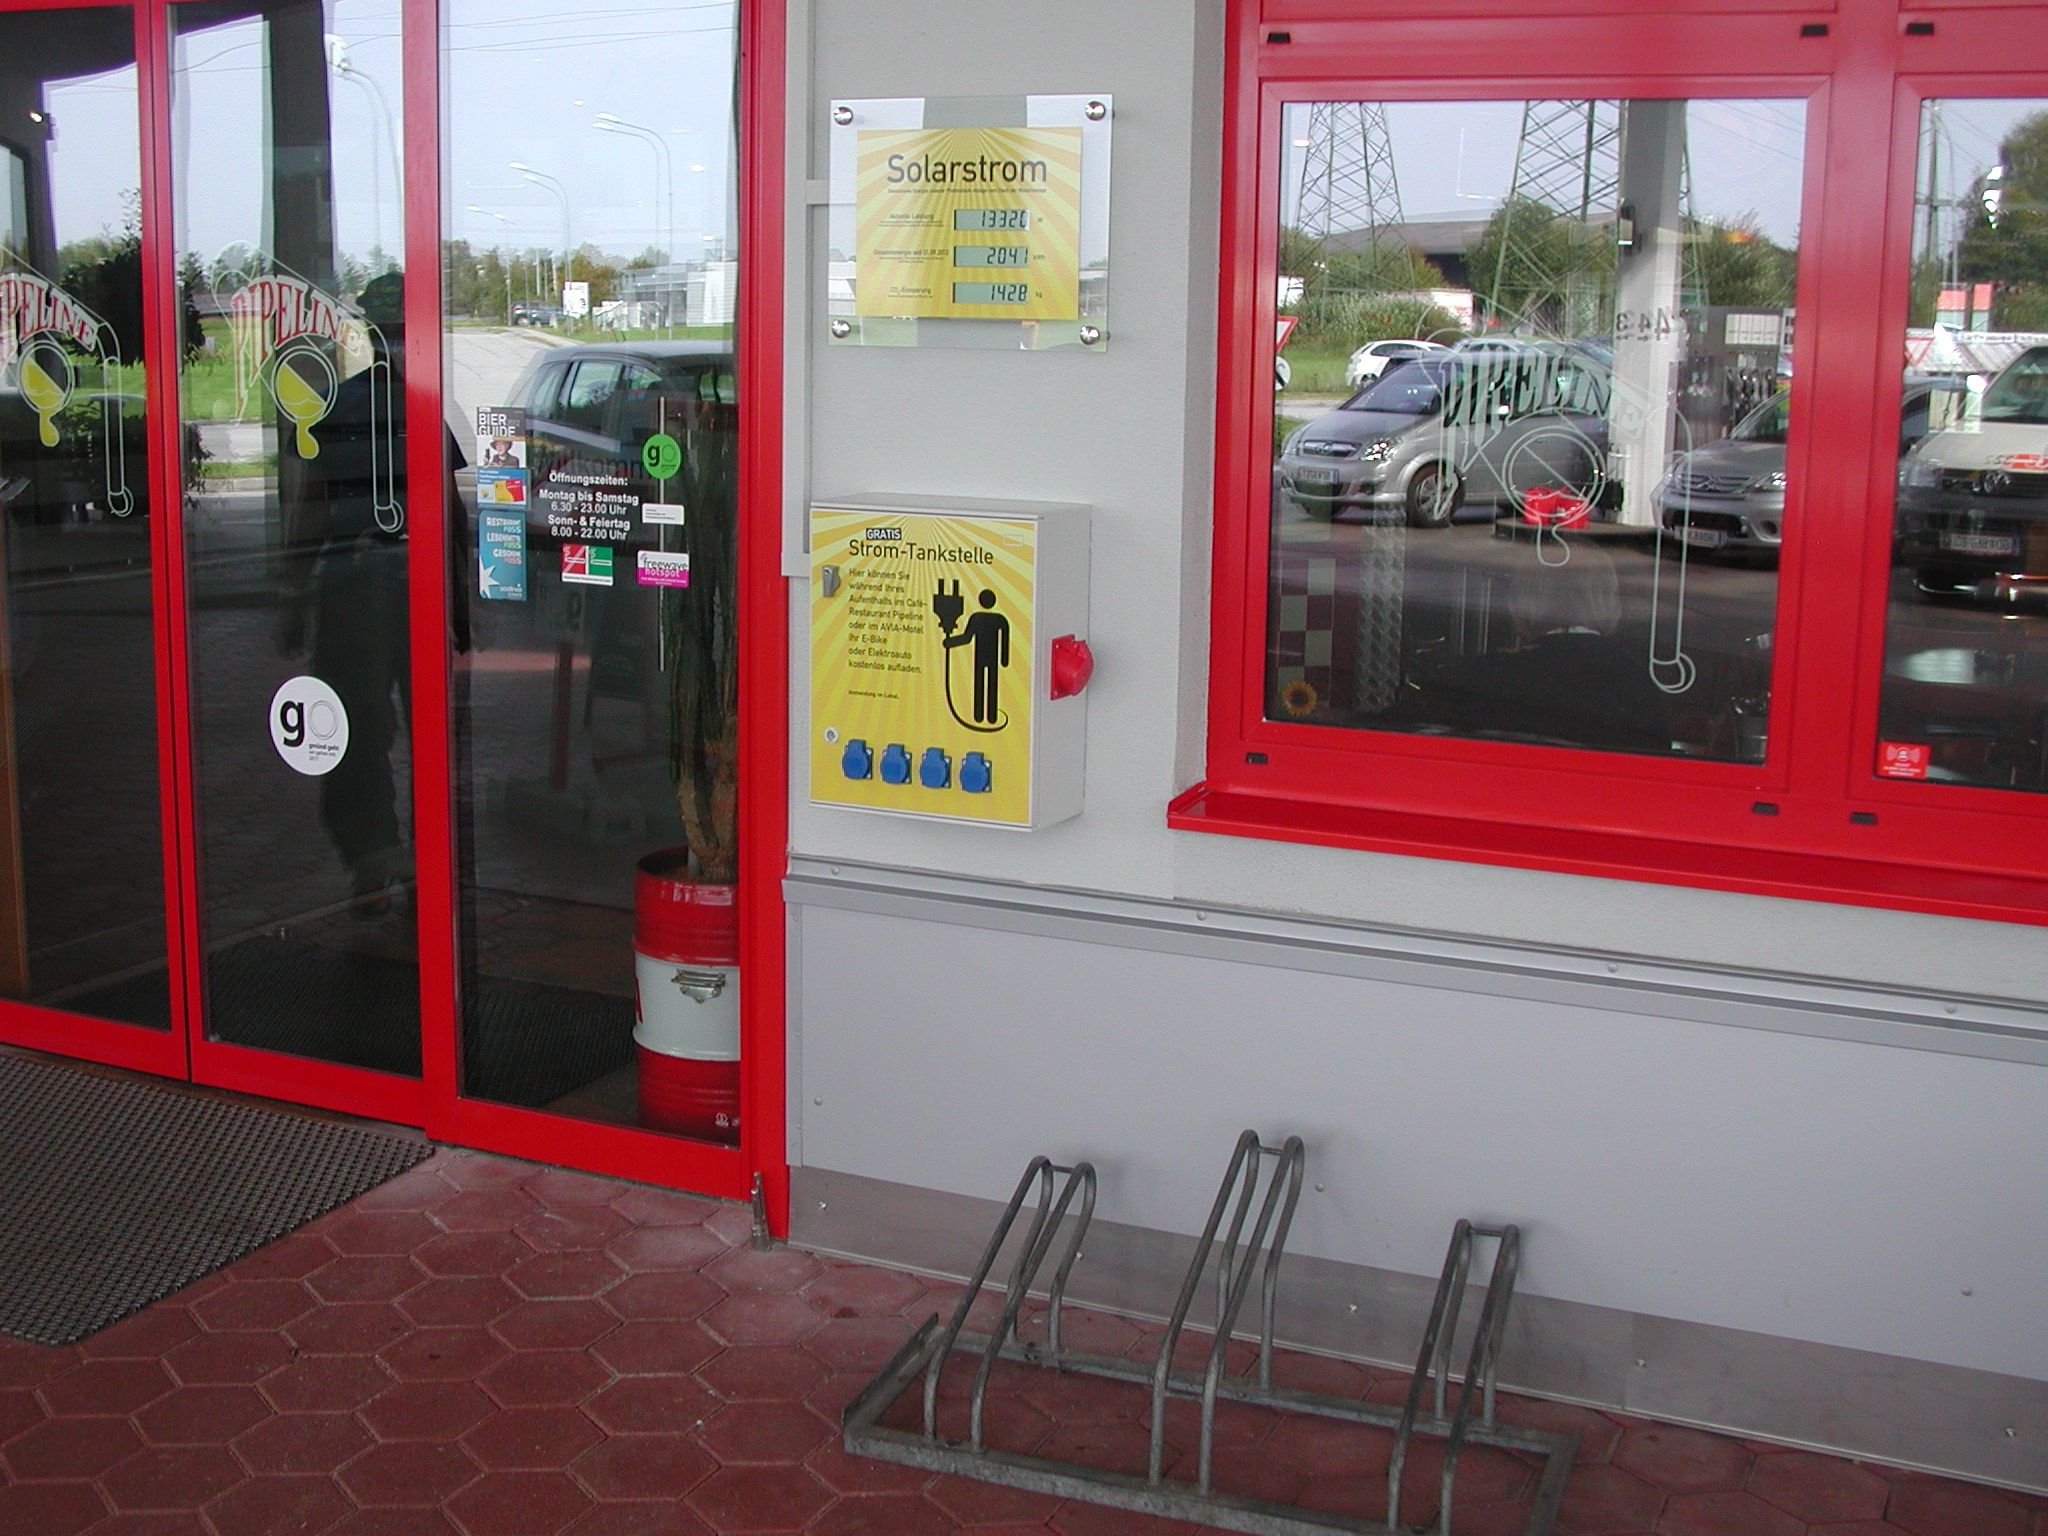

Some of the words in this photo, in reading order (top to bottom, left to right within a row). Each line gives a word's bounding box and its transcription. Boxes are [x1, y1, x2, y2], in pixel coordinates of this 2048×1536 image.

[886, 153, 1047, 184] Solarstrom
[986, 247, 1029, 265] 2041
[990, 284, 1028, 301] 1428
[479, 413, 507, 426] BIER
[479, 425, 517, 437] GUIDE
[549, 469, 628, 486] Öffnungszeiten:
[539, 488, 576, 503] Montag
[577, 491, 593, 502] bis
[595, 491, 639, 506] Samstag
[551, 501, 572, 512] 6.30
[580, 502, 607, 514] 23.00
[609, 504, 627, 515] Uhr
[548, 514, 577, 526] Sonn-
[579, 516, 588, 526] &
[589, 516, 631, 531] Feiertag
[551, 526, 572, 537] 8.00
[580, 528, 608, 539] 22.00
[609, 529, 627, 540] Uhr
[866, 529, 901, 540] GRATIS
[849, 540, 994, 565] Strom-Tankstelle
[643, 557, 688, 570] freewave
[645, 567, 680, 578] hotspot
[849, 568, 865, 578] Hier
[868, 569, 896, 579] können
[898, 571, 911, 580] Sie
[849, 607, 891, 618] Restaurant
[893, 610, 924, 621] Pipeline
[848, 621, 866, 630] oder
[868, 621, 879, 630] im
[880, 622, 924, 634] AVIA-Motel
[861, 634, 888, 645] E-Bike
[848, 646, 866, 656] oder
[868, 647, 912, 660] Elektroauto
[848, 659, 885, 671] kostenlos
